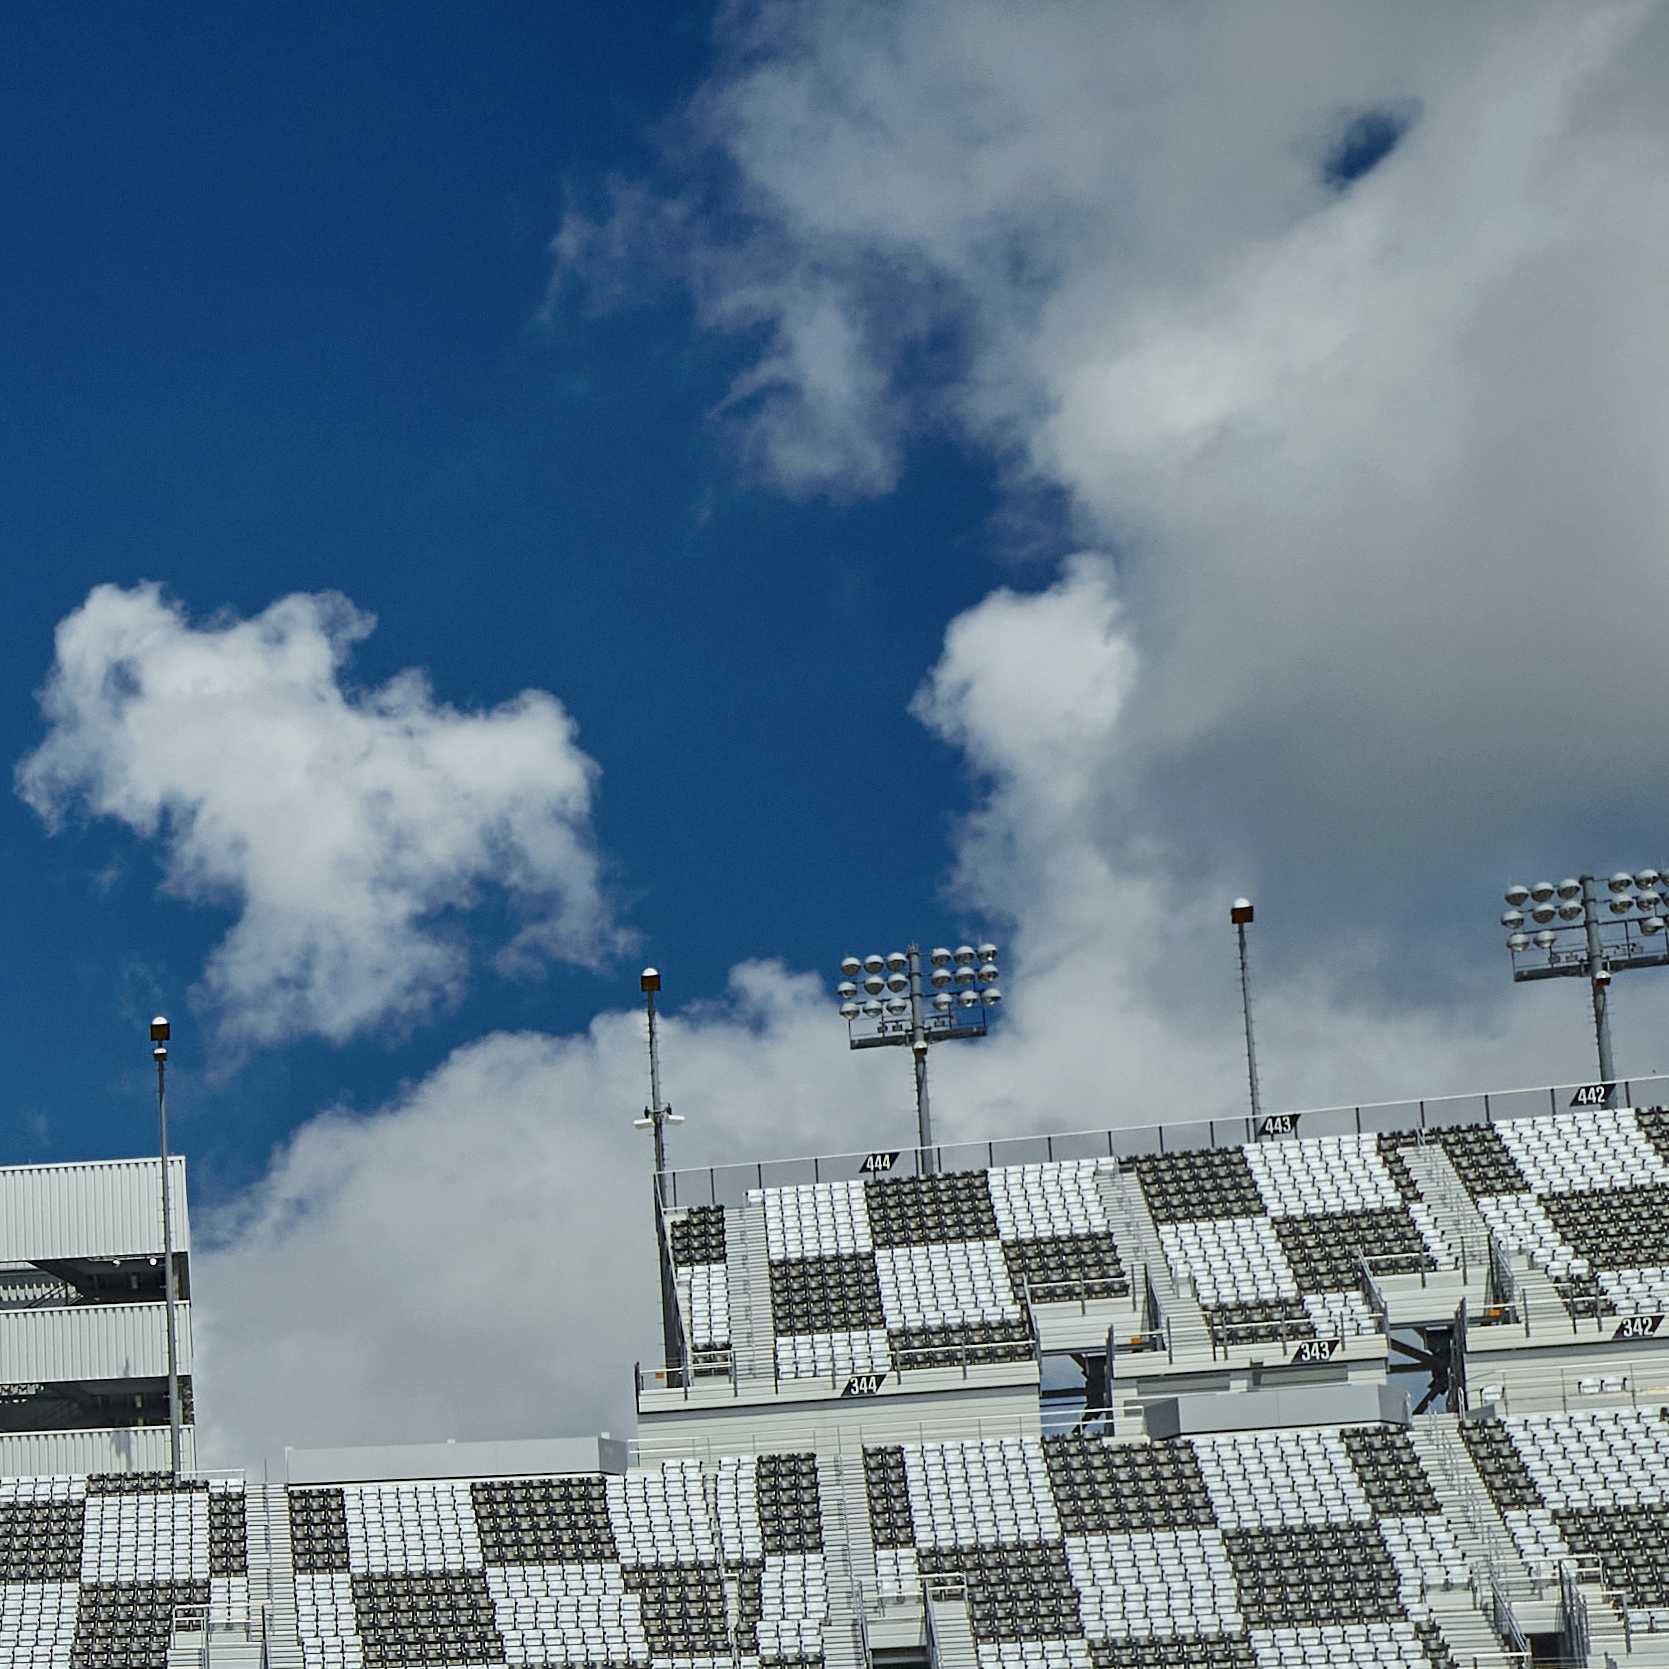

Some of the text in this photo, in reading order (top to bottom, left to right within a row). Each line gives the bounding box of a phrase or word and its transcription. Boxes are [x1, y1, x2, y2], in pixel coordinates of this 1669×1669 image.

[1578, 1087, 1605, 1104] 442
[1265, 1116, 1290, 1133] 443
[865, 1154, 891, 1171] 444
[1622, 1318, 1652, 1337] 342
[1301, 1343, 1330, 1361] 343
[851, 1377, 877, 1394] 344
